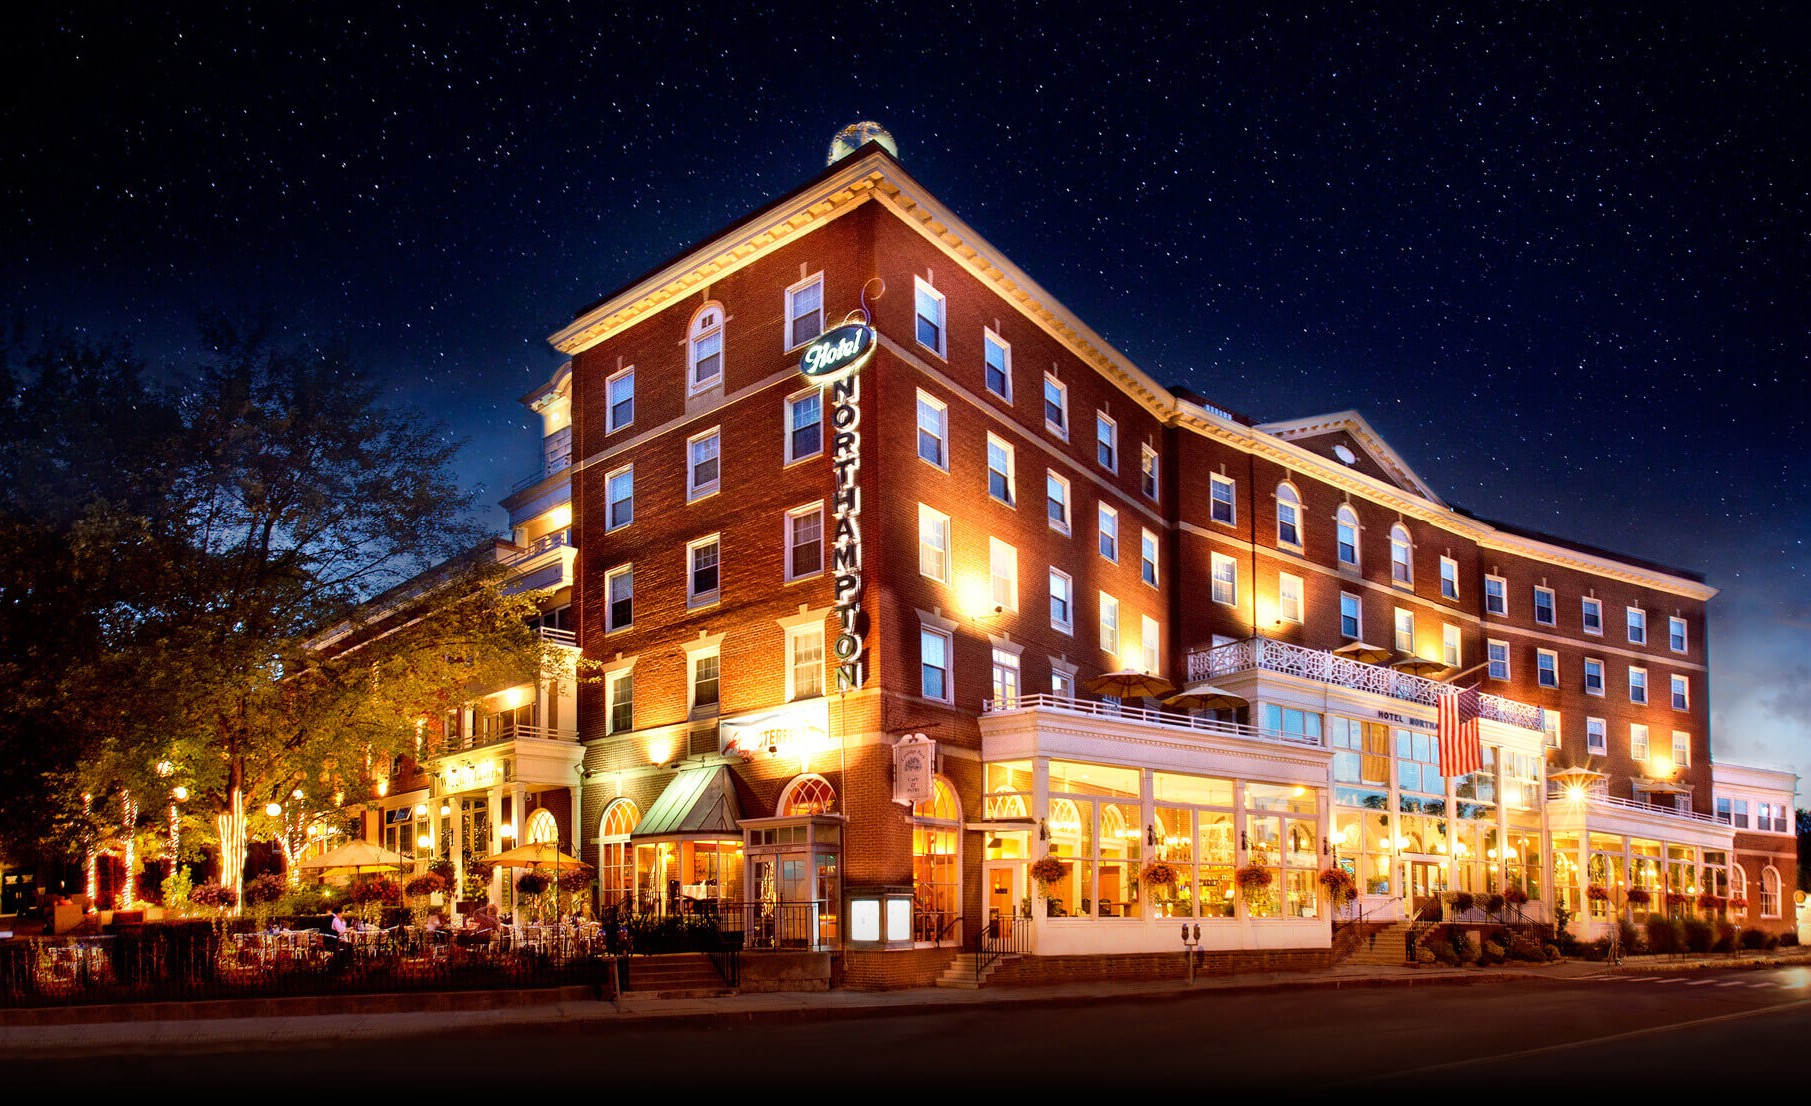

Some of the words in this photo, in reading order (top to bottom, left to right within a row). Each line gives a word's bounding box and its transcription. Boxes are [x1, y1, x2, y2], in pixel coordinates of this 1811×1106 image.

[805, 328, 863, 373] Hotel
[831, 376, 857, 690] NORTHAMPTON
[1378, 711, 1403, 723] HOTEL
